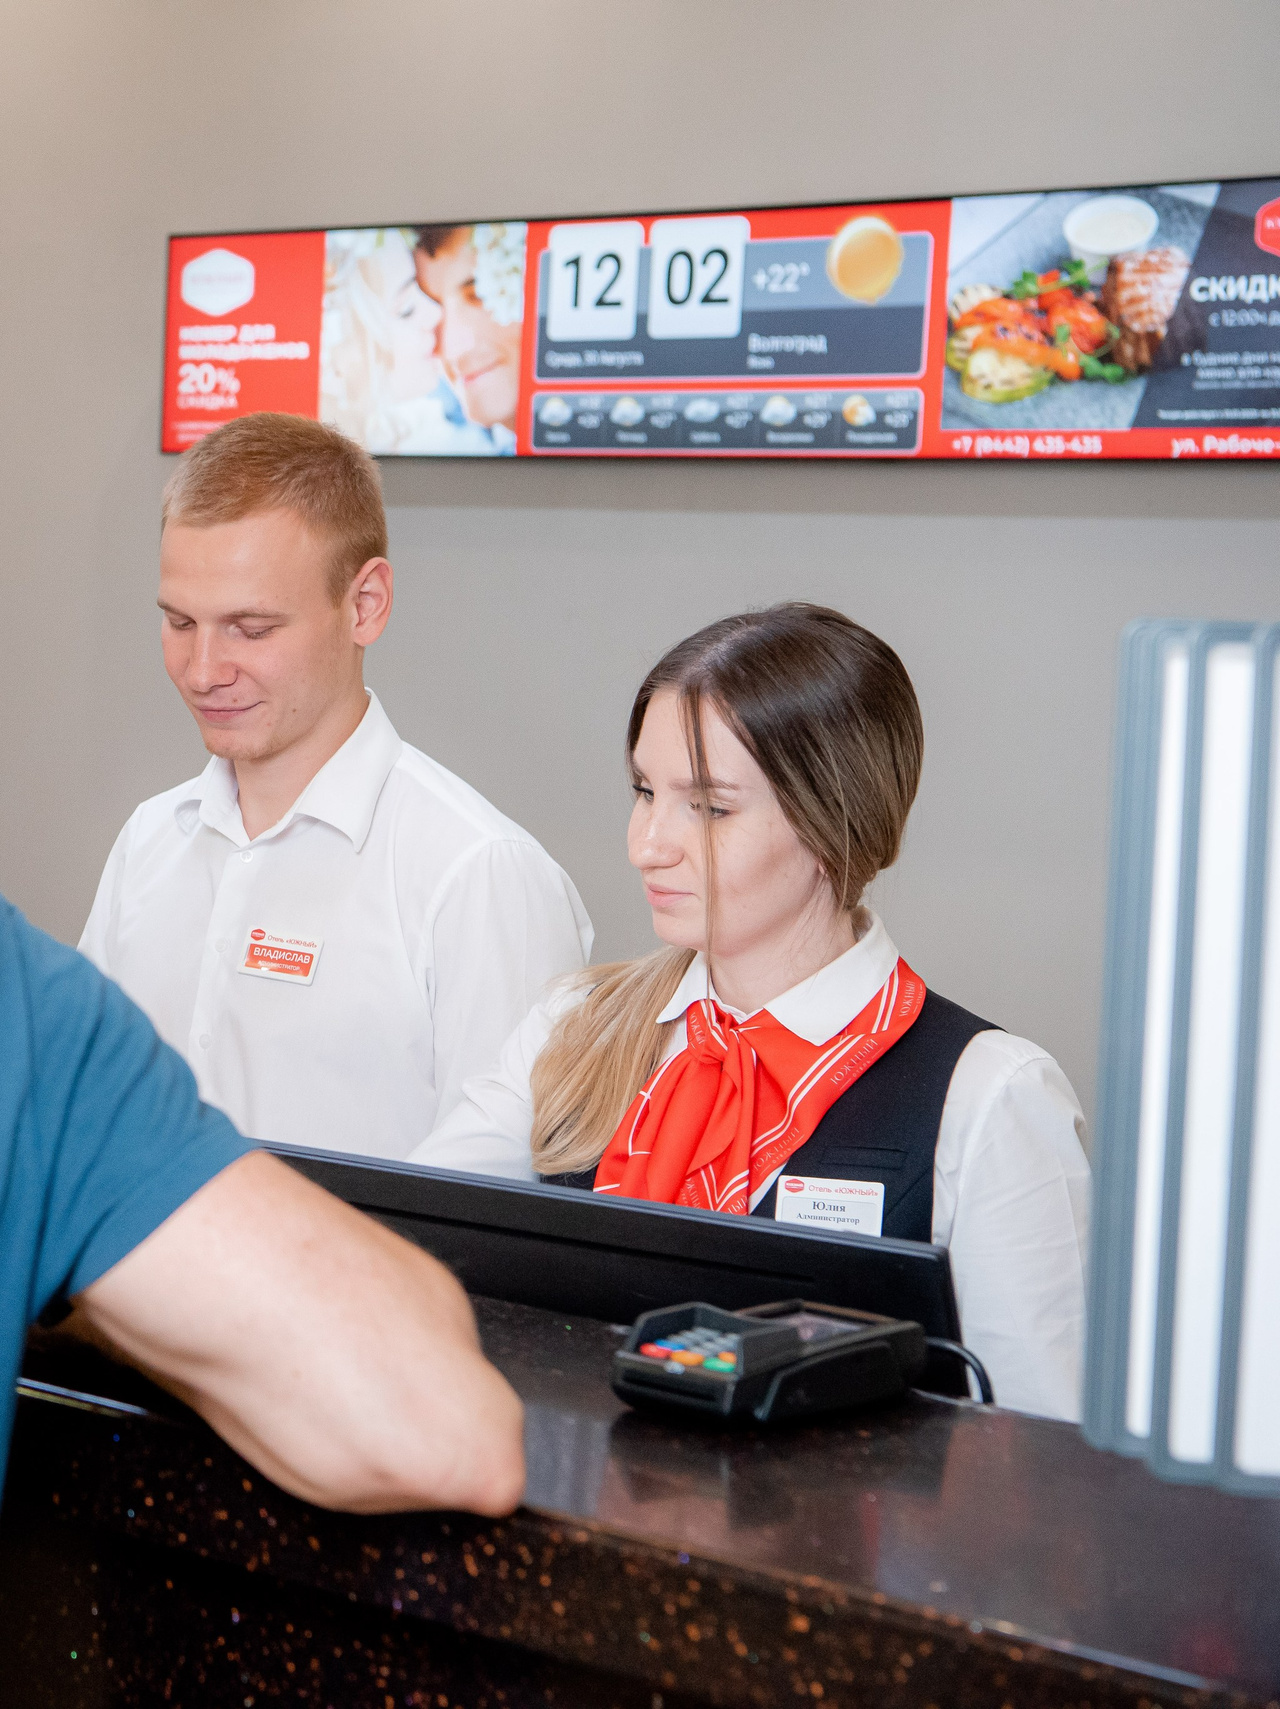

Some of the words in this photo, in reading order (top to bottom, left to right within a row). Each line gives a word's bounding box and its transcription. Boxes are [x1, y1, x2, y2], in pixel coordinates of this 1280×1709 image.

[564, 252, 622, 309] 12
[665, 248, 729, 305] 02
[748, 333, 828, 356] Волгоград
[178, 363, 240, 395] 20%
[1171, 437, 1200, 458] ул.
[253, 947, 311, 964] ВЛАДИСЛАВ
[830, 1038, 878, 1085] ЮЖНЫЙ
[753, 1127, 800, 1171] ЮЖНЫЙ
[808, 1184, 833, 1194] Отель
[834, 1187, 879, 1197] «ЮЖНЫЙ»
[812, 1201, 847, 1213] Юлия
[796, 1212, 860, 1225] Администратор
